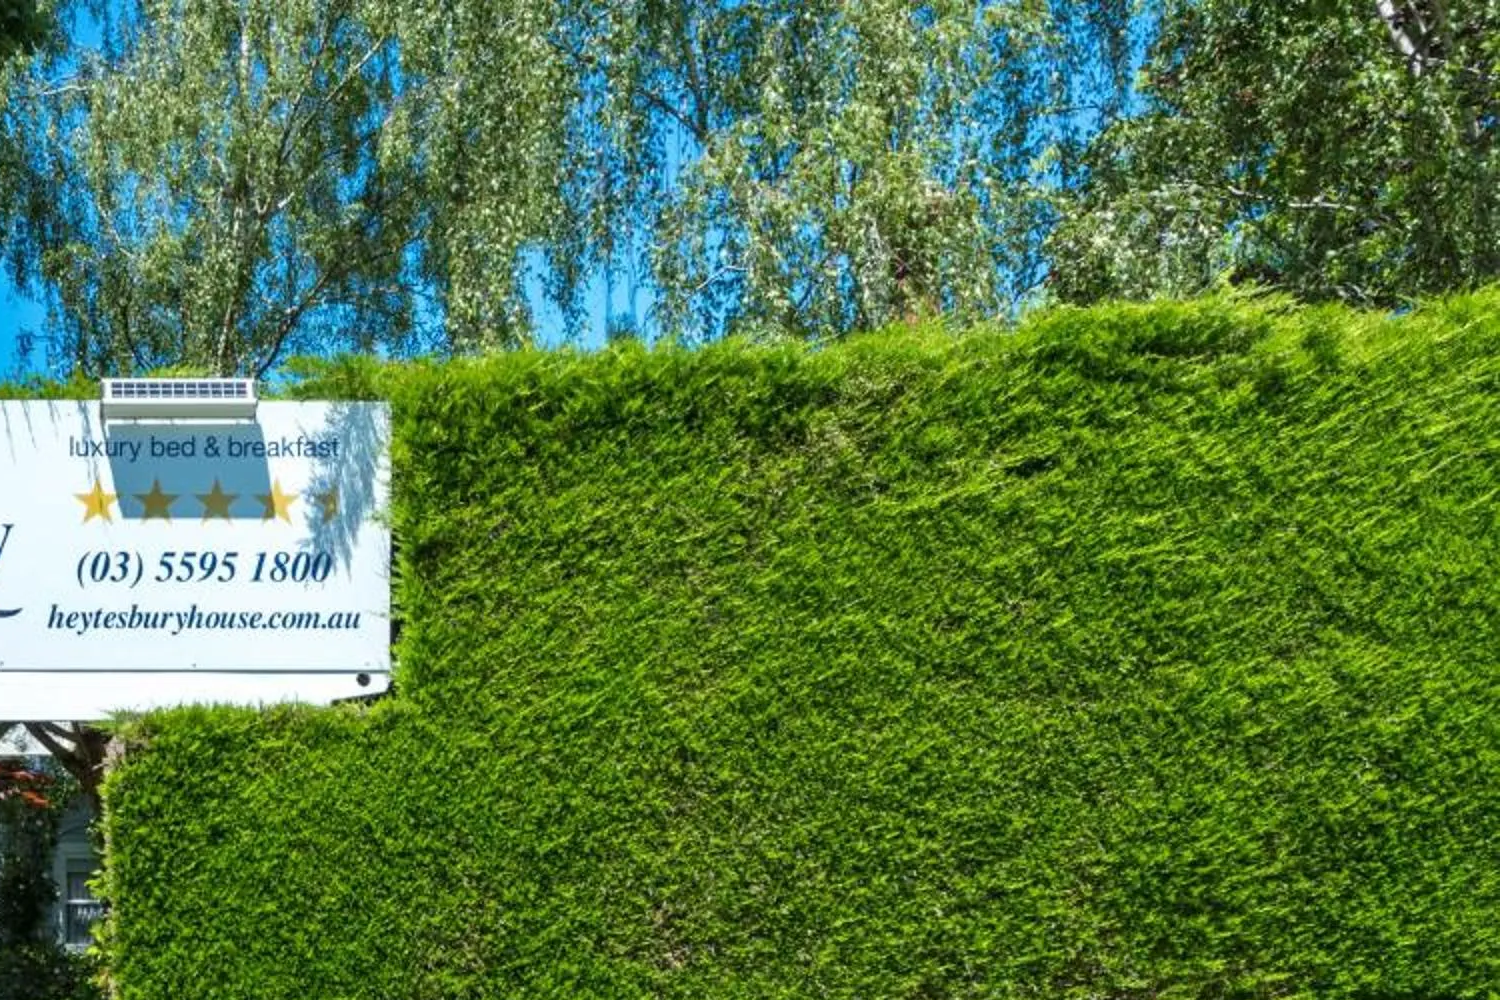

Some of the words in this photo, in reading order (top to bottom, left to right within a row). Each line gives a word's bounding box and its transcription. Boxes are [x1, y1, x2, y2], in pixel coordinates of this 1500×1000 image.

[69, 435, 142, 462] luxury
[151, 435, 196, 458] bed
[204, 436, 221, 458] &
[228, 435, 340, 458] breakfast
[77, 551, 144, 588] (03)
[155, 551, 239, 583] 5595
[250, 551, 334, 583] 1800
[47, 604, 361, 636] heytesburyhouse.com.au
